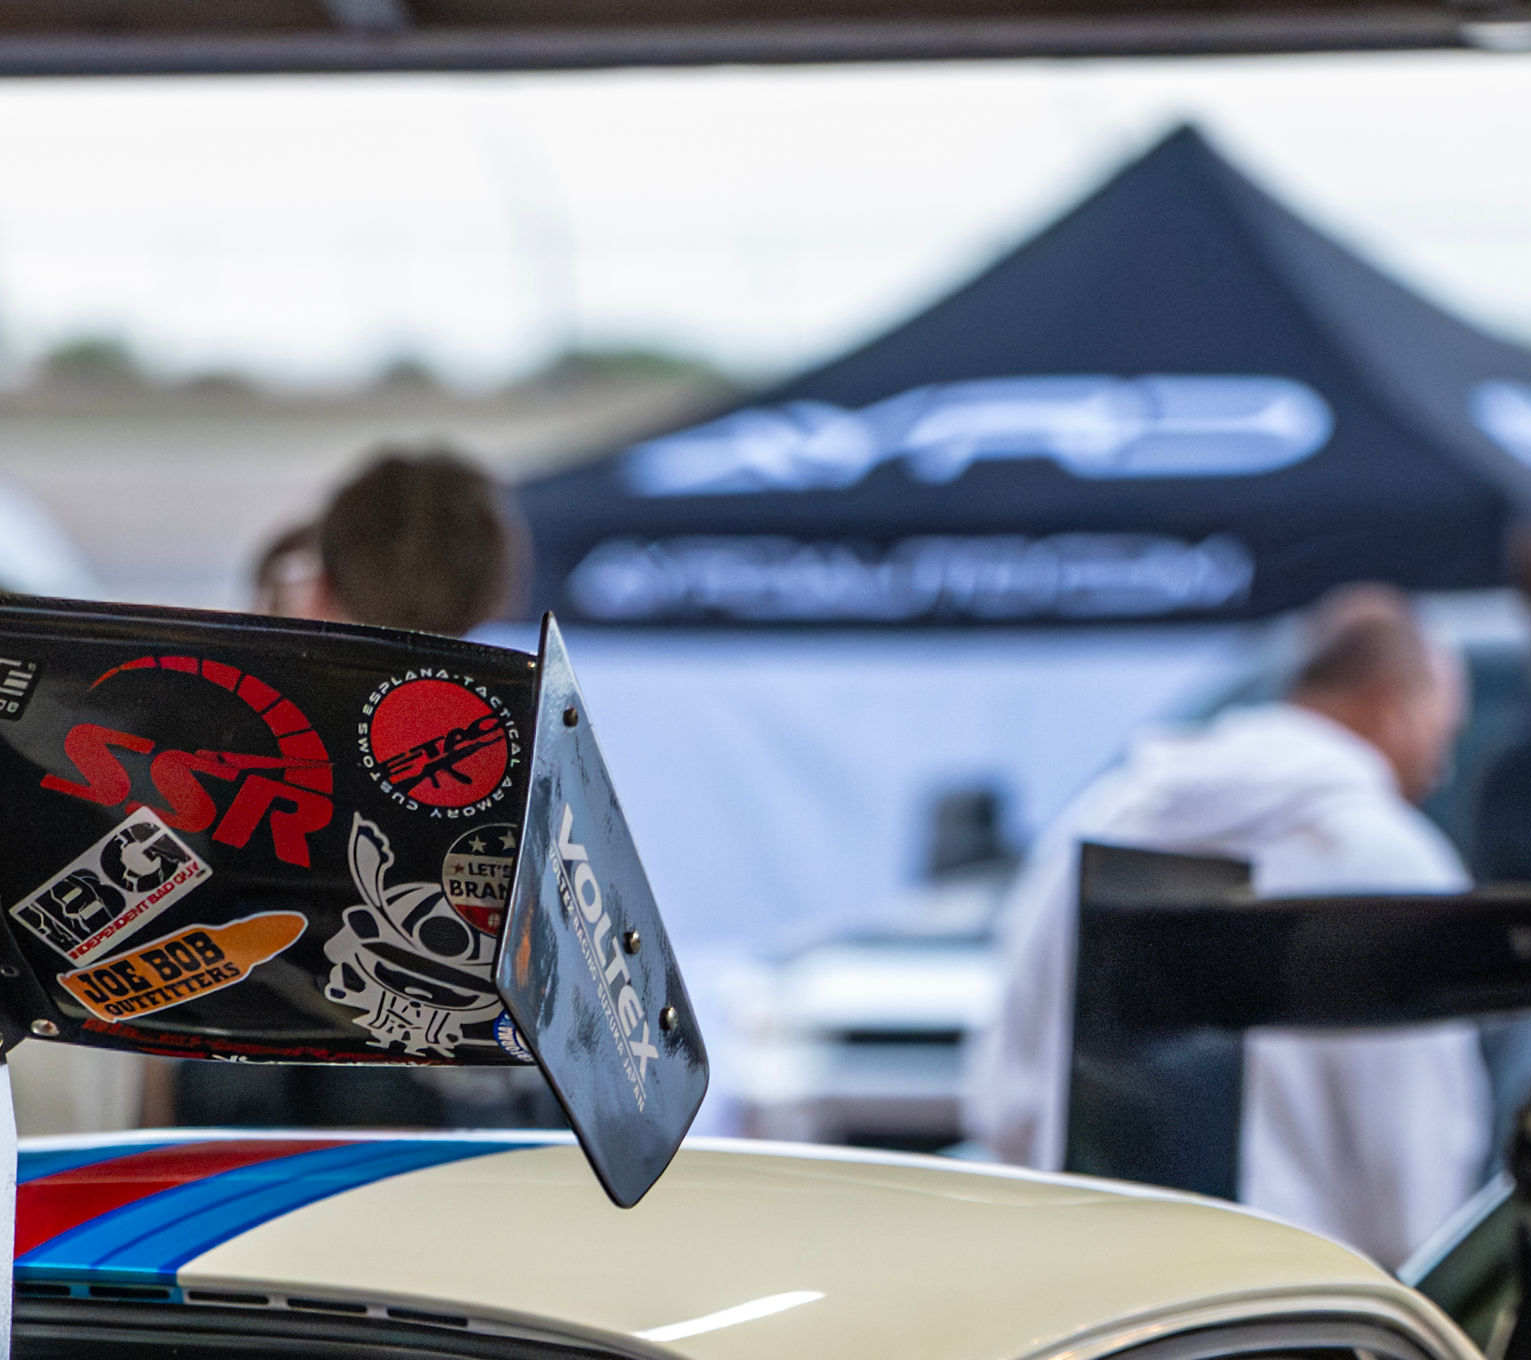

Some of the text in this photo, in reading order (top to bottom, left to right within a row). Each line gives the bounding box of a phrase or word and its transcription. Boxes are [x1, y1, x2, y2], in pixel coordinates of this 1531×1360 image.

[40, 723, 334, 869] SSR
[78, 931, 227, 1004] JOE BOB
[103, 962, 241, 1017] OUTFITTERS
[558, 803, 659, 1082] VOLTEX
